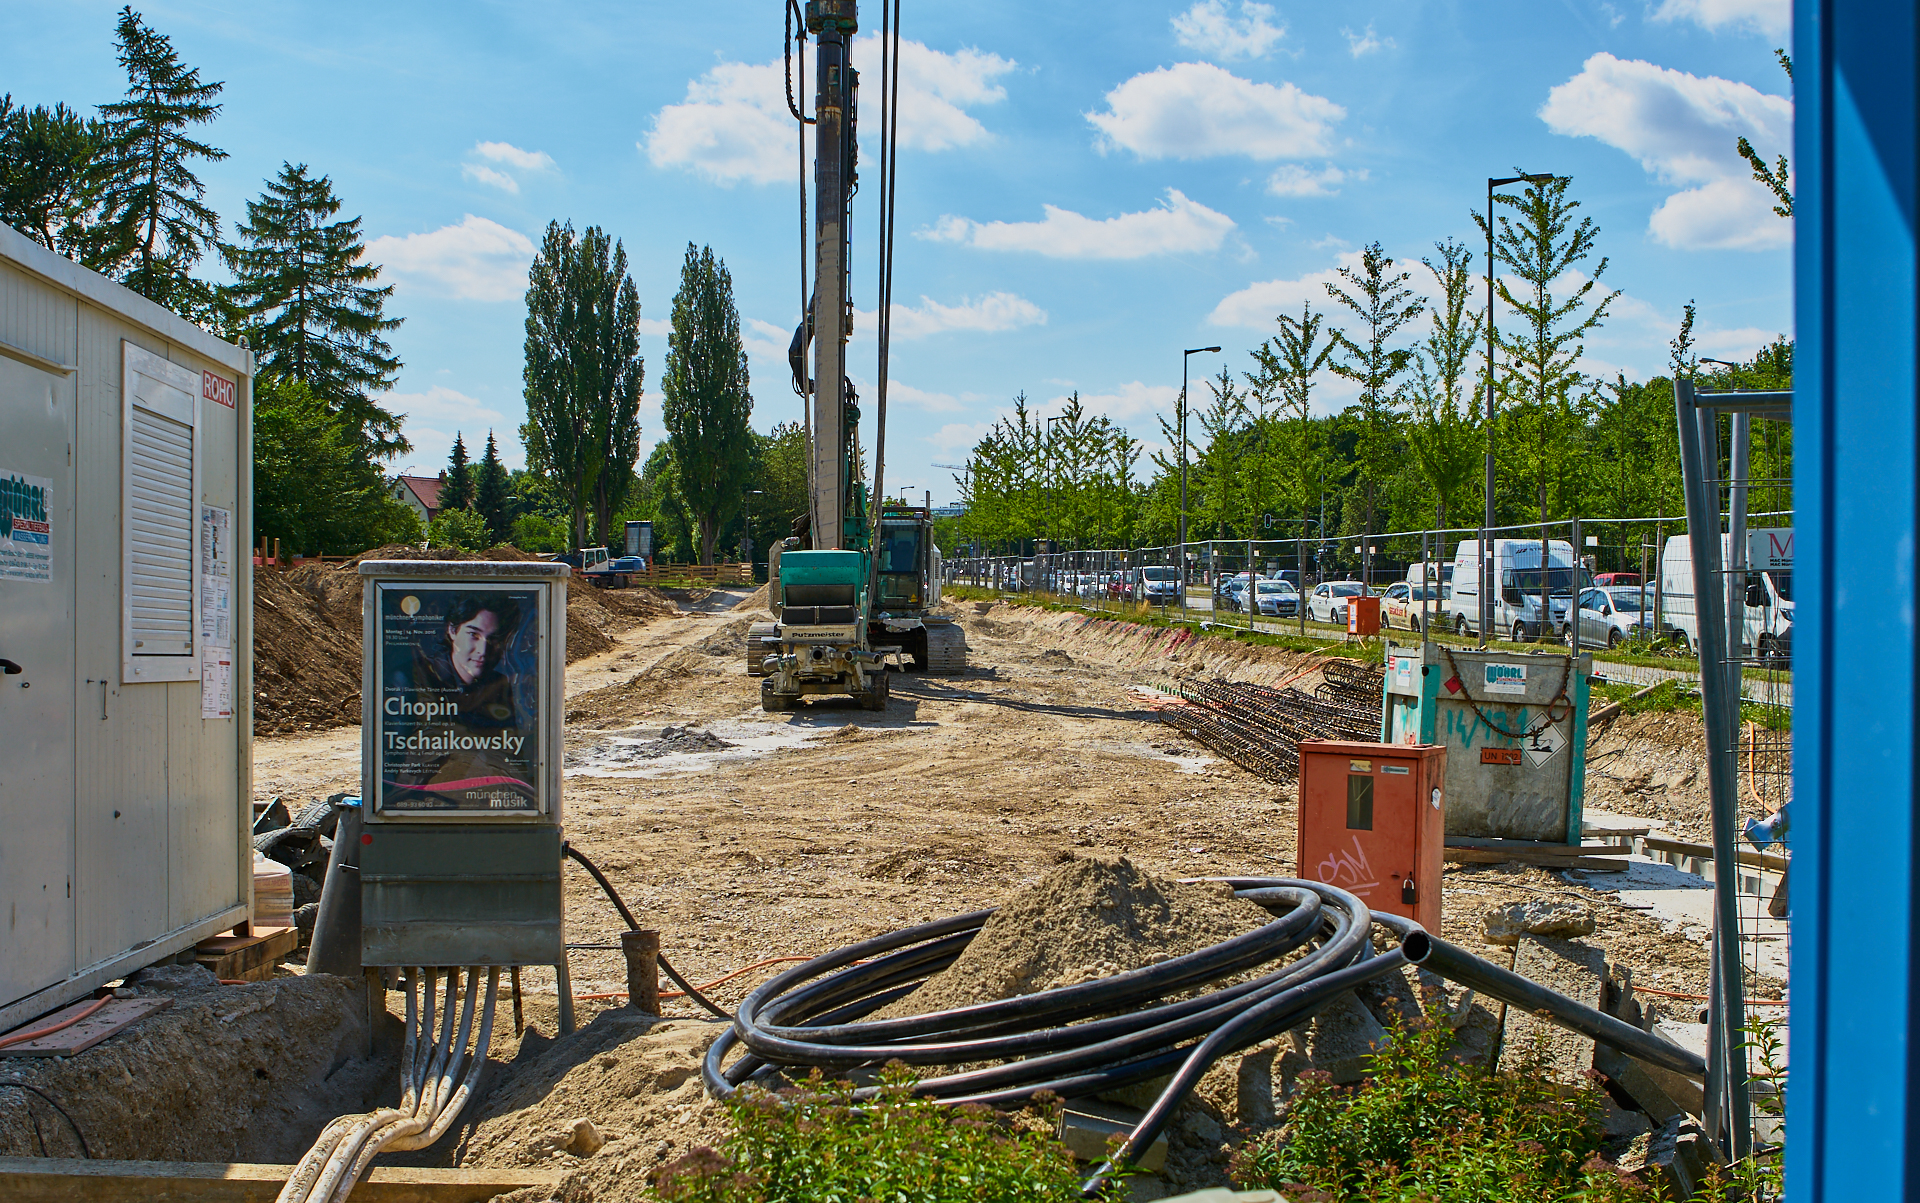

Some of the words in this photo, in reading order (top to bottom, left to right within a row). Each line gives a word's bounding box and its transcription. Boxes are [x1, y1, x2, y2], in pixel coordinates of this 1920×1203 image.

[205, 372, 234, 406] ROHO
[1767, 533, 1794, 558] M
[1486, 664, 1522, 683] WÖHRL
[384, 695, 458, 721] Chopin
[384, 730, 525, 755] Tschaikowsky
[1484, 752, 1497, 760] UN
[466, 789, 517, 799] münchen
[490, 796, 527, 808] musik
